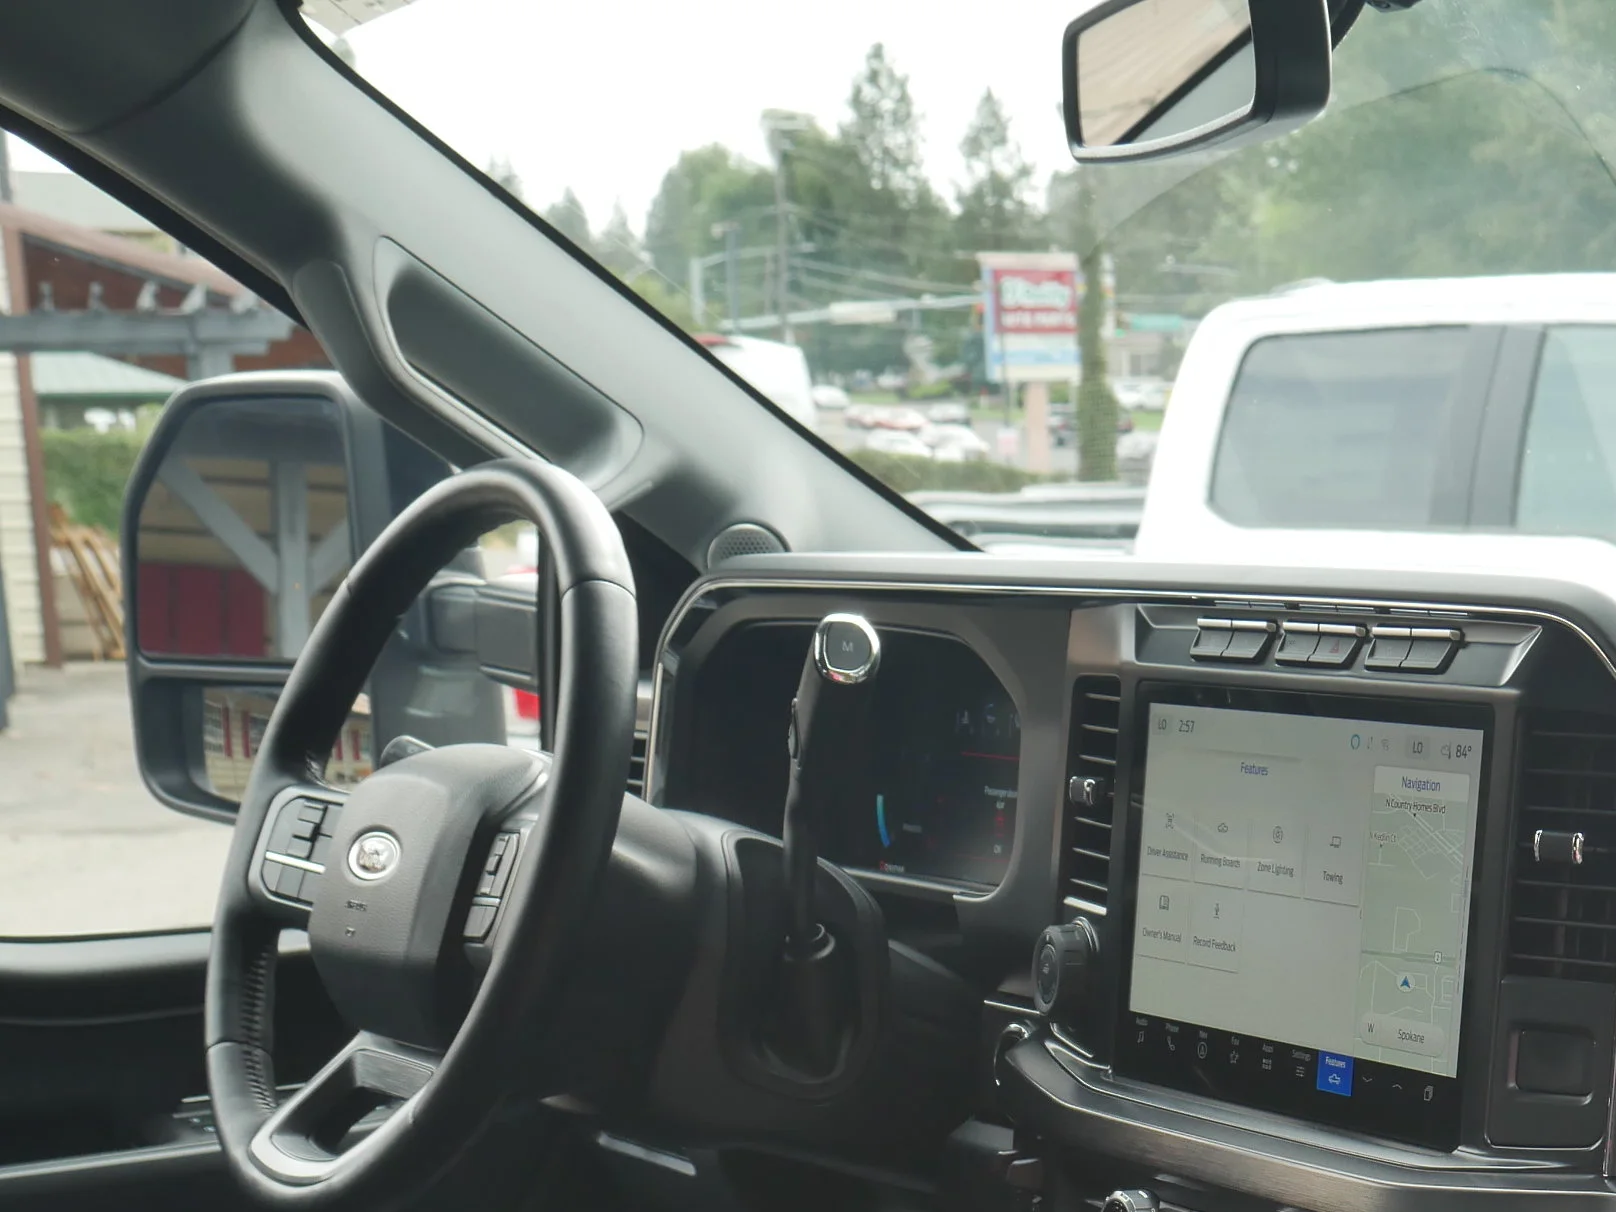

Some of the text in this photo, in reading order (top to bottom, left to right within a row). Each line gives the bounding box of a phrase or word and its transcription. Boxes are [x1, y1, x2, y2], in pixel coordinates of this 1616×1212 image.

[842, 640, 854, 652] M
[1178, 720, 1195, 733] 2:57
[1413, 741, 1423, 753] LO
[1240, 762, 1269, 776] Features
[1402, 776, 1441, 791] Navigation
[1391, 799, 1411, 810] Country
[1413, 802, 1432, 812] Homes
[1433, 803, 1445, 814] Blvd
[1147, 846, 1188, 861] Driver Assistance
[1201, 854, 1241, 869] Running Boards
[1257, 861, 1294, 878] Zone Lighting
[1323, 870, 1343, 885] Towing
[1143, 927, 1181, 943] Owner's Manual
[1193, 935, 1236, 952] Record Feedback
[1368, 1023, 1374, 1032] W
[1398, 1028, 1424, 1043] Spokane
[1326, 1056, 1346, 1068] Features
